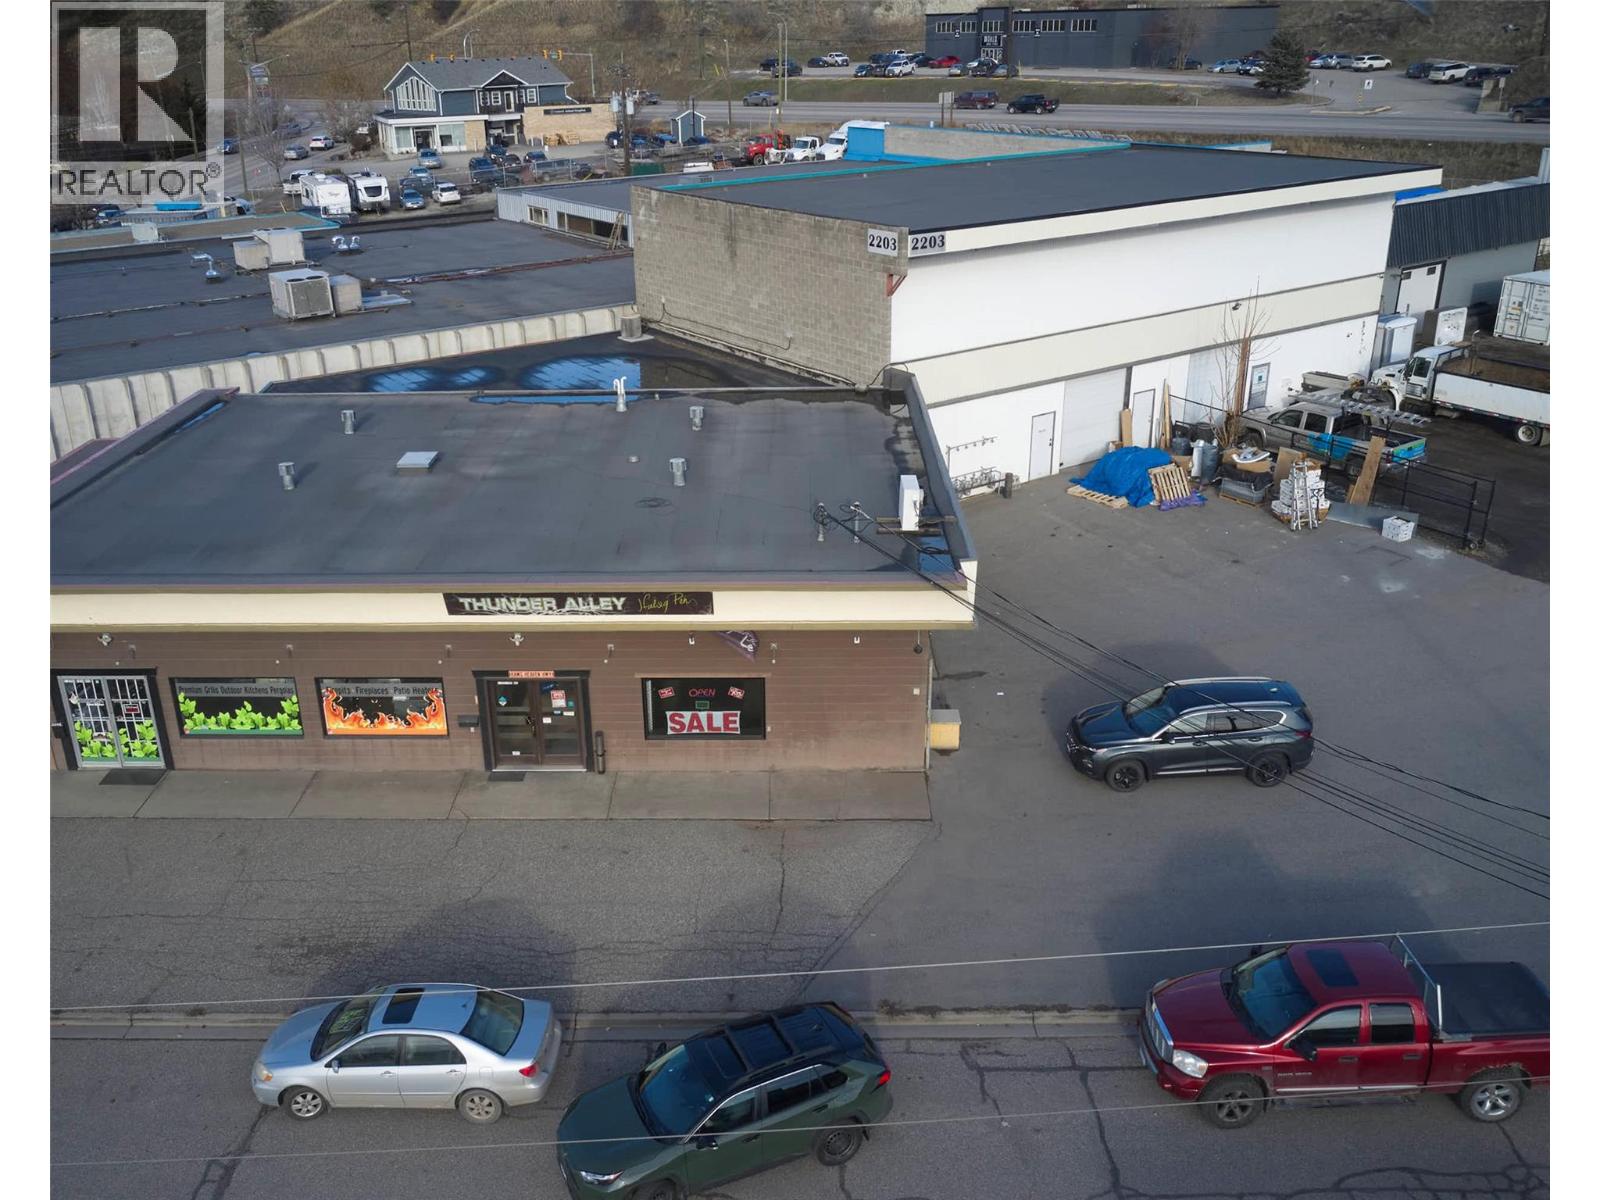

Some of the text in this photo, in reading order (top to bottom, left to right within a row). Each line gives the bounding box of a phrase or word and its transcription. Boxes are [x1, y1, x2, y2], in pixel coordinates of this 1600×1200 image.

[869, 234, 897, 251] 2203
[911, 235, 945, 250] 2203
[459, 597, 557, 611] THUNDER
[565, 597, 627, 611] ALLEY
[220, 686, 242, 695] Outdoor
[244, 686, 268, 695] Kitchens
[270, 686, 295, 696] Pergolas
[355, 686, 389, 696] Fireplaces
[393, 686, 411, 695] Patio
[688, 688, 716, 698] OPEN
[669, 712, 739, 733] SALE
